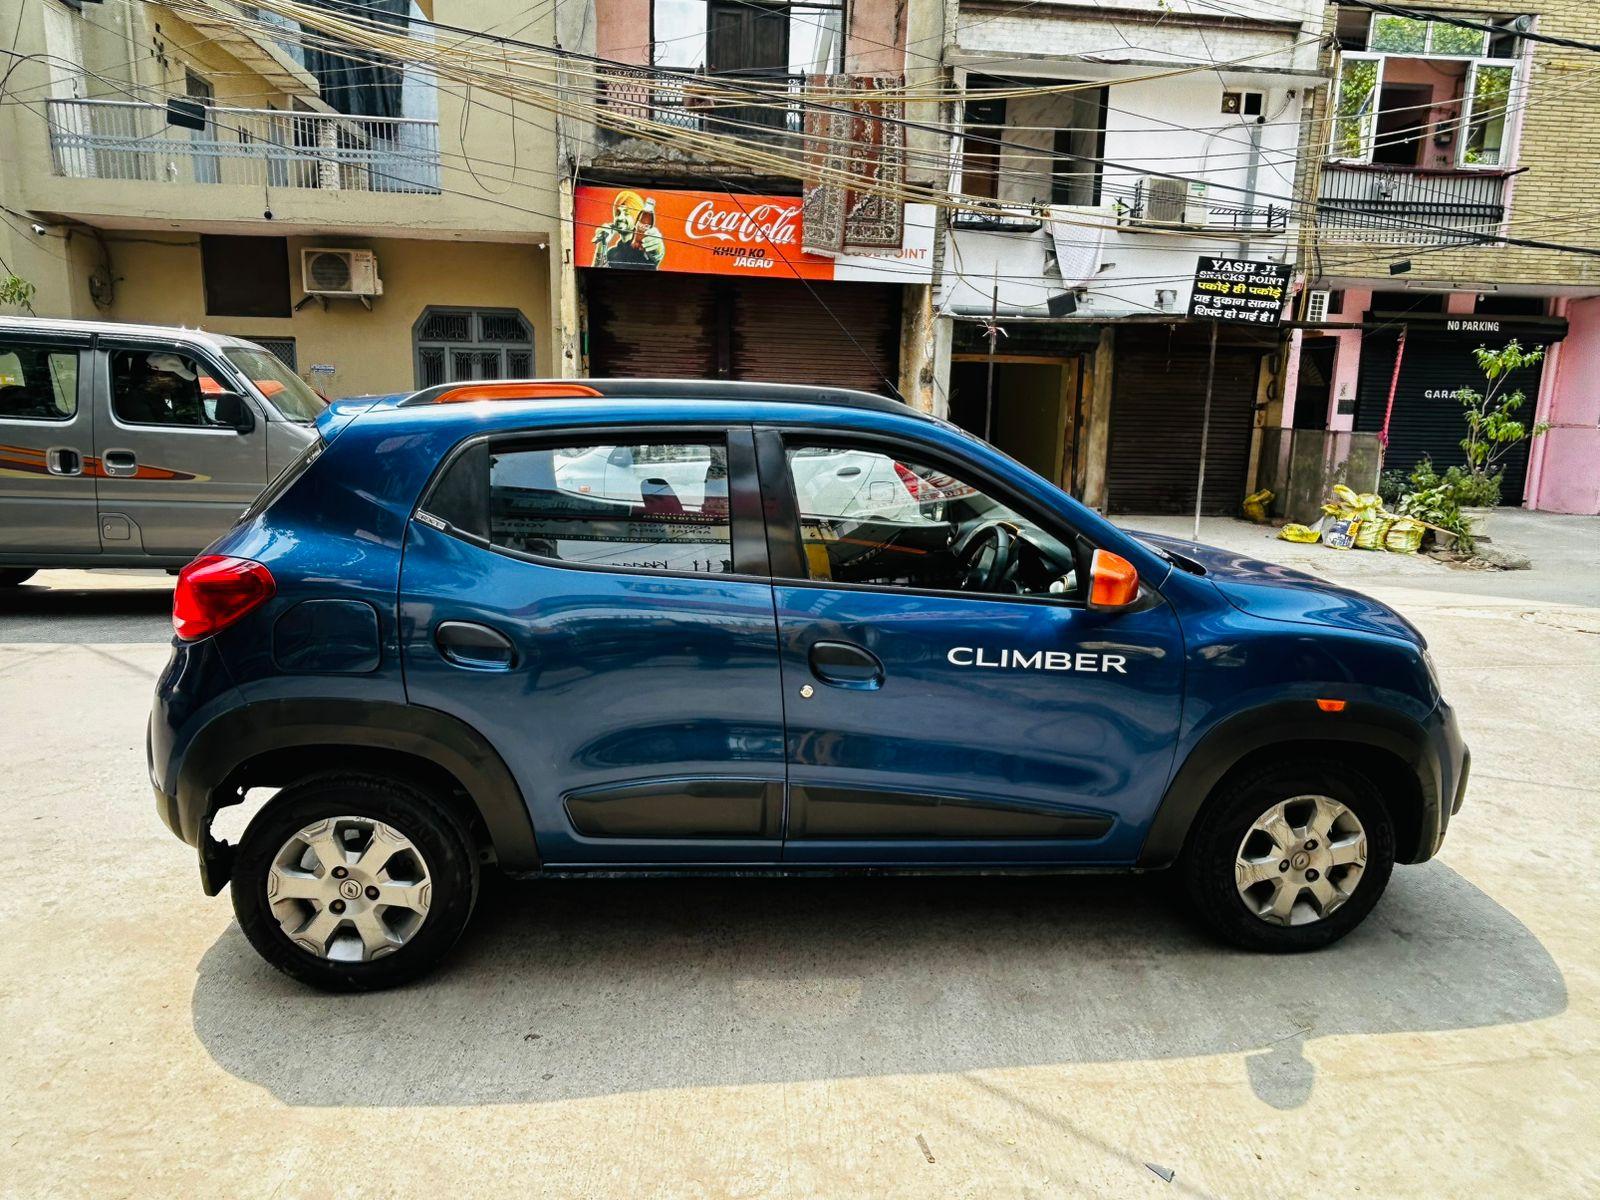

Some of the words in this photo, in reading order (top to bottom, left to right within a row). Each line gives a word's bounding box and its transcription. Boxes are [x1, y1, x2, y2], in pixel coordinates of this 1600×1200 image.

[713, 246, 746, 258] KHUD
[748, 248, 766, 259] KO
[1211, 259, 1257, 273] YASH
[1260, 265, 1278, 276] JI
[1199, 270, 1246, 283] SNACKS
[1248, 275, 1285, 286] POINT
[1232, 283, 1247, 294] ही
[1193, 294, 1212, 304] यह
[1213, 295, 1246, 308] दुकान
[1247, 299, 1281, 310] सामने
[1224, 308, 1238, 319] हो
[1239, 310, 1259, 321] गई
[1447, 320, 1460, 331] NO
[1462, 320, 1500, 332] PARKING
[947, 646, 1127, 674] CLIMBER
